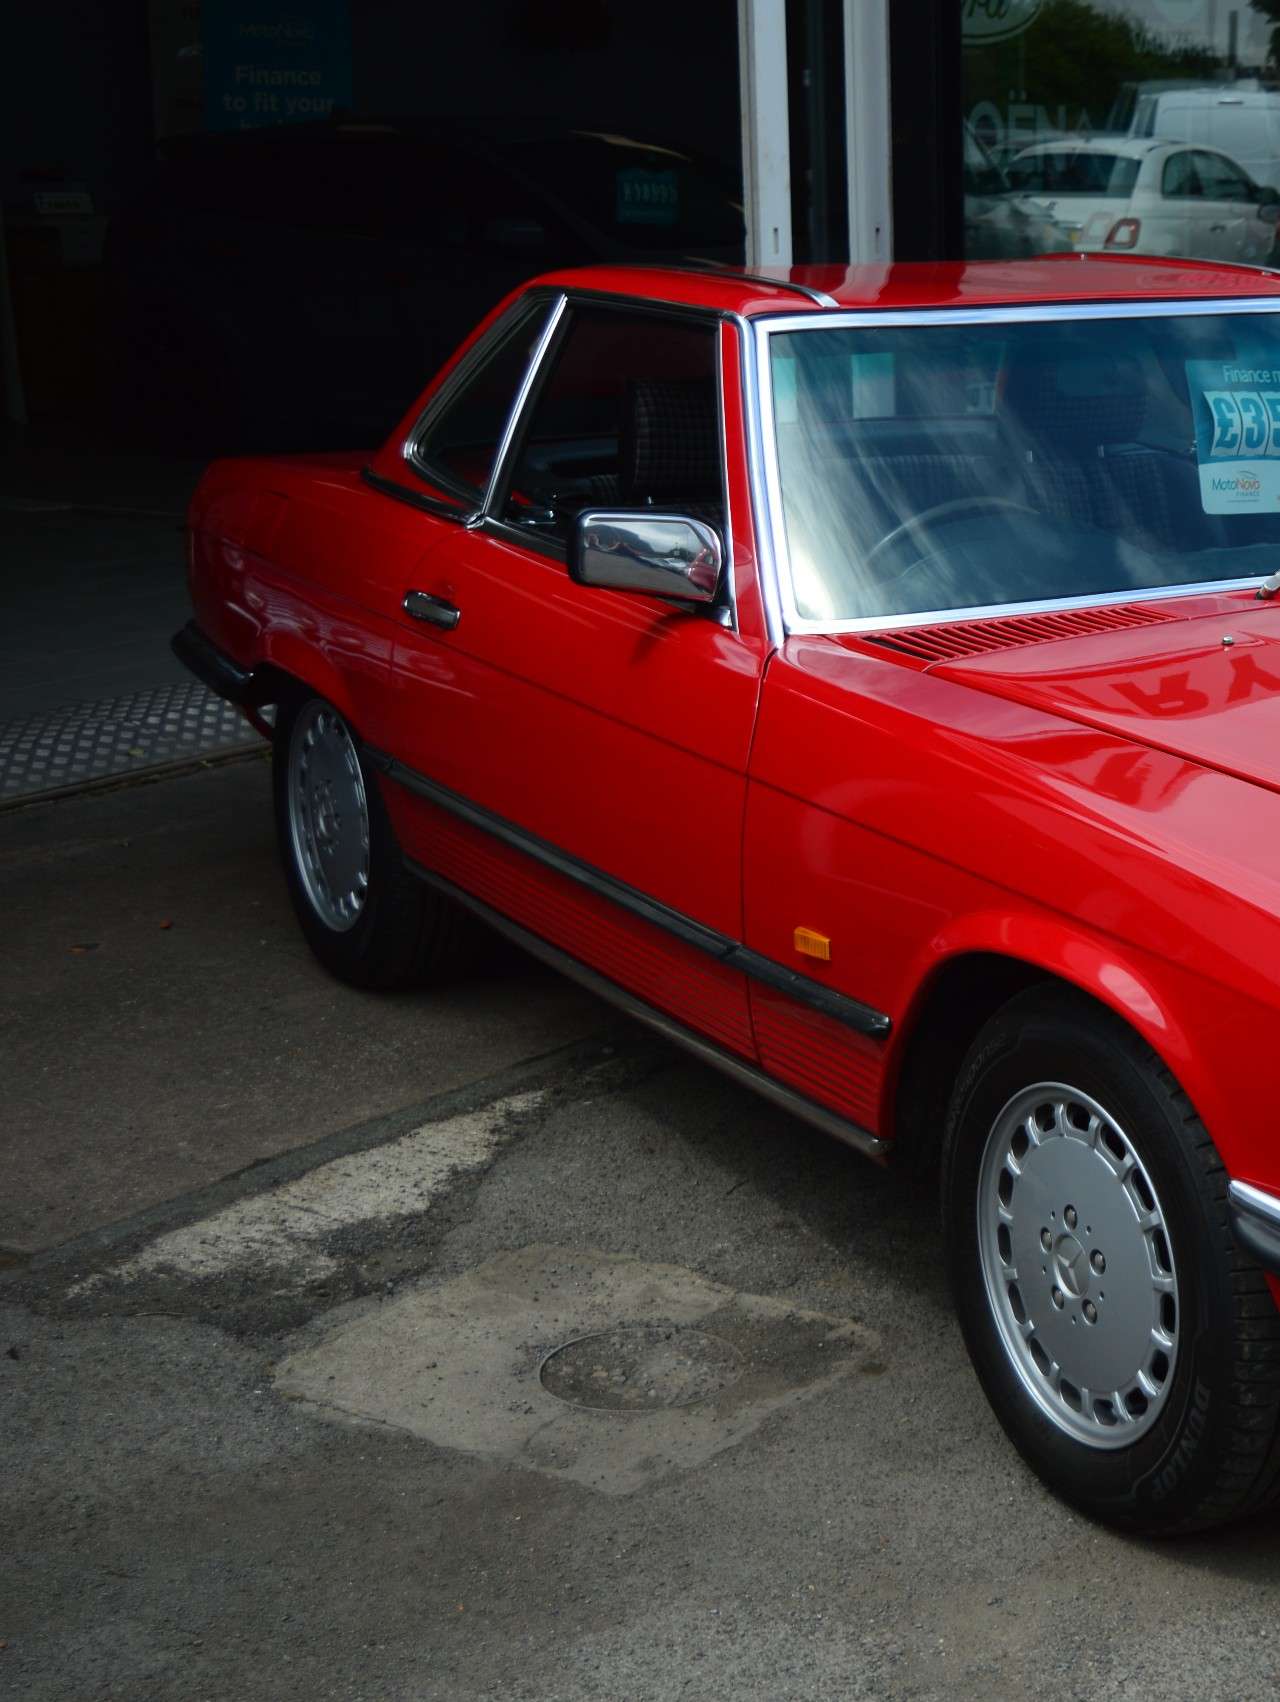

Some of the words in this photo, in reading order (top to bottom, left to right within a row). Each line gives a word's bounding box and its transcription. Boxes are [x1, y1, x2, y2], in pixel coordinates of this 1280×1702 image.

[233, 64, 322, 87] Finance
[222, 92, 248, 112] to
[254, 91, 281, 112] fit
[285, 95, 336, 117] your
[1223, 365, 1271, 384] Finance
